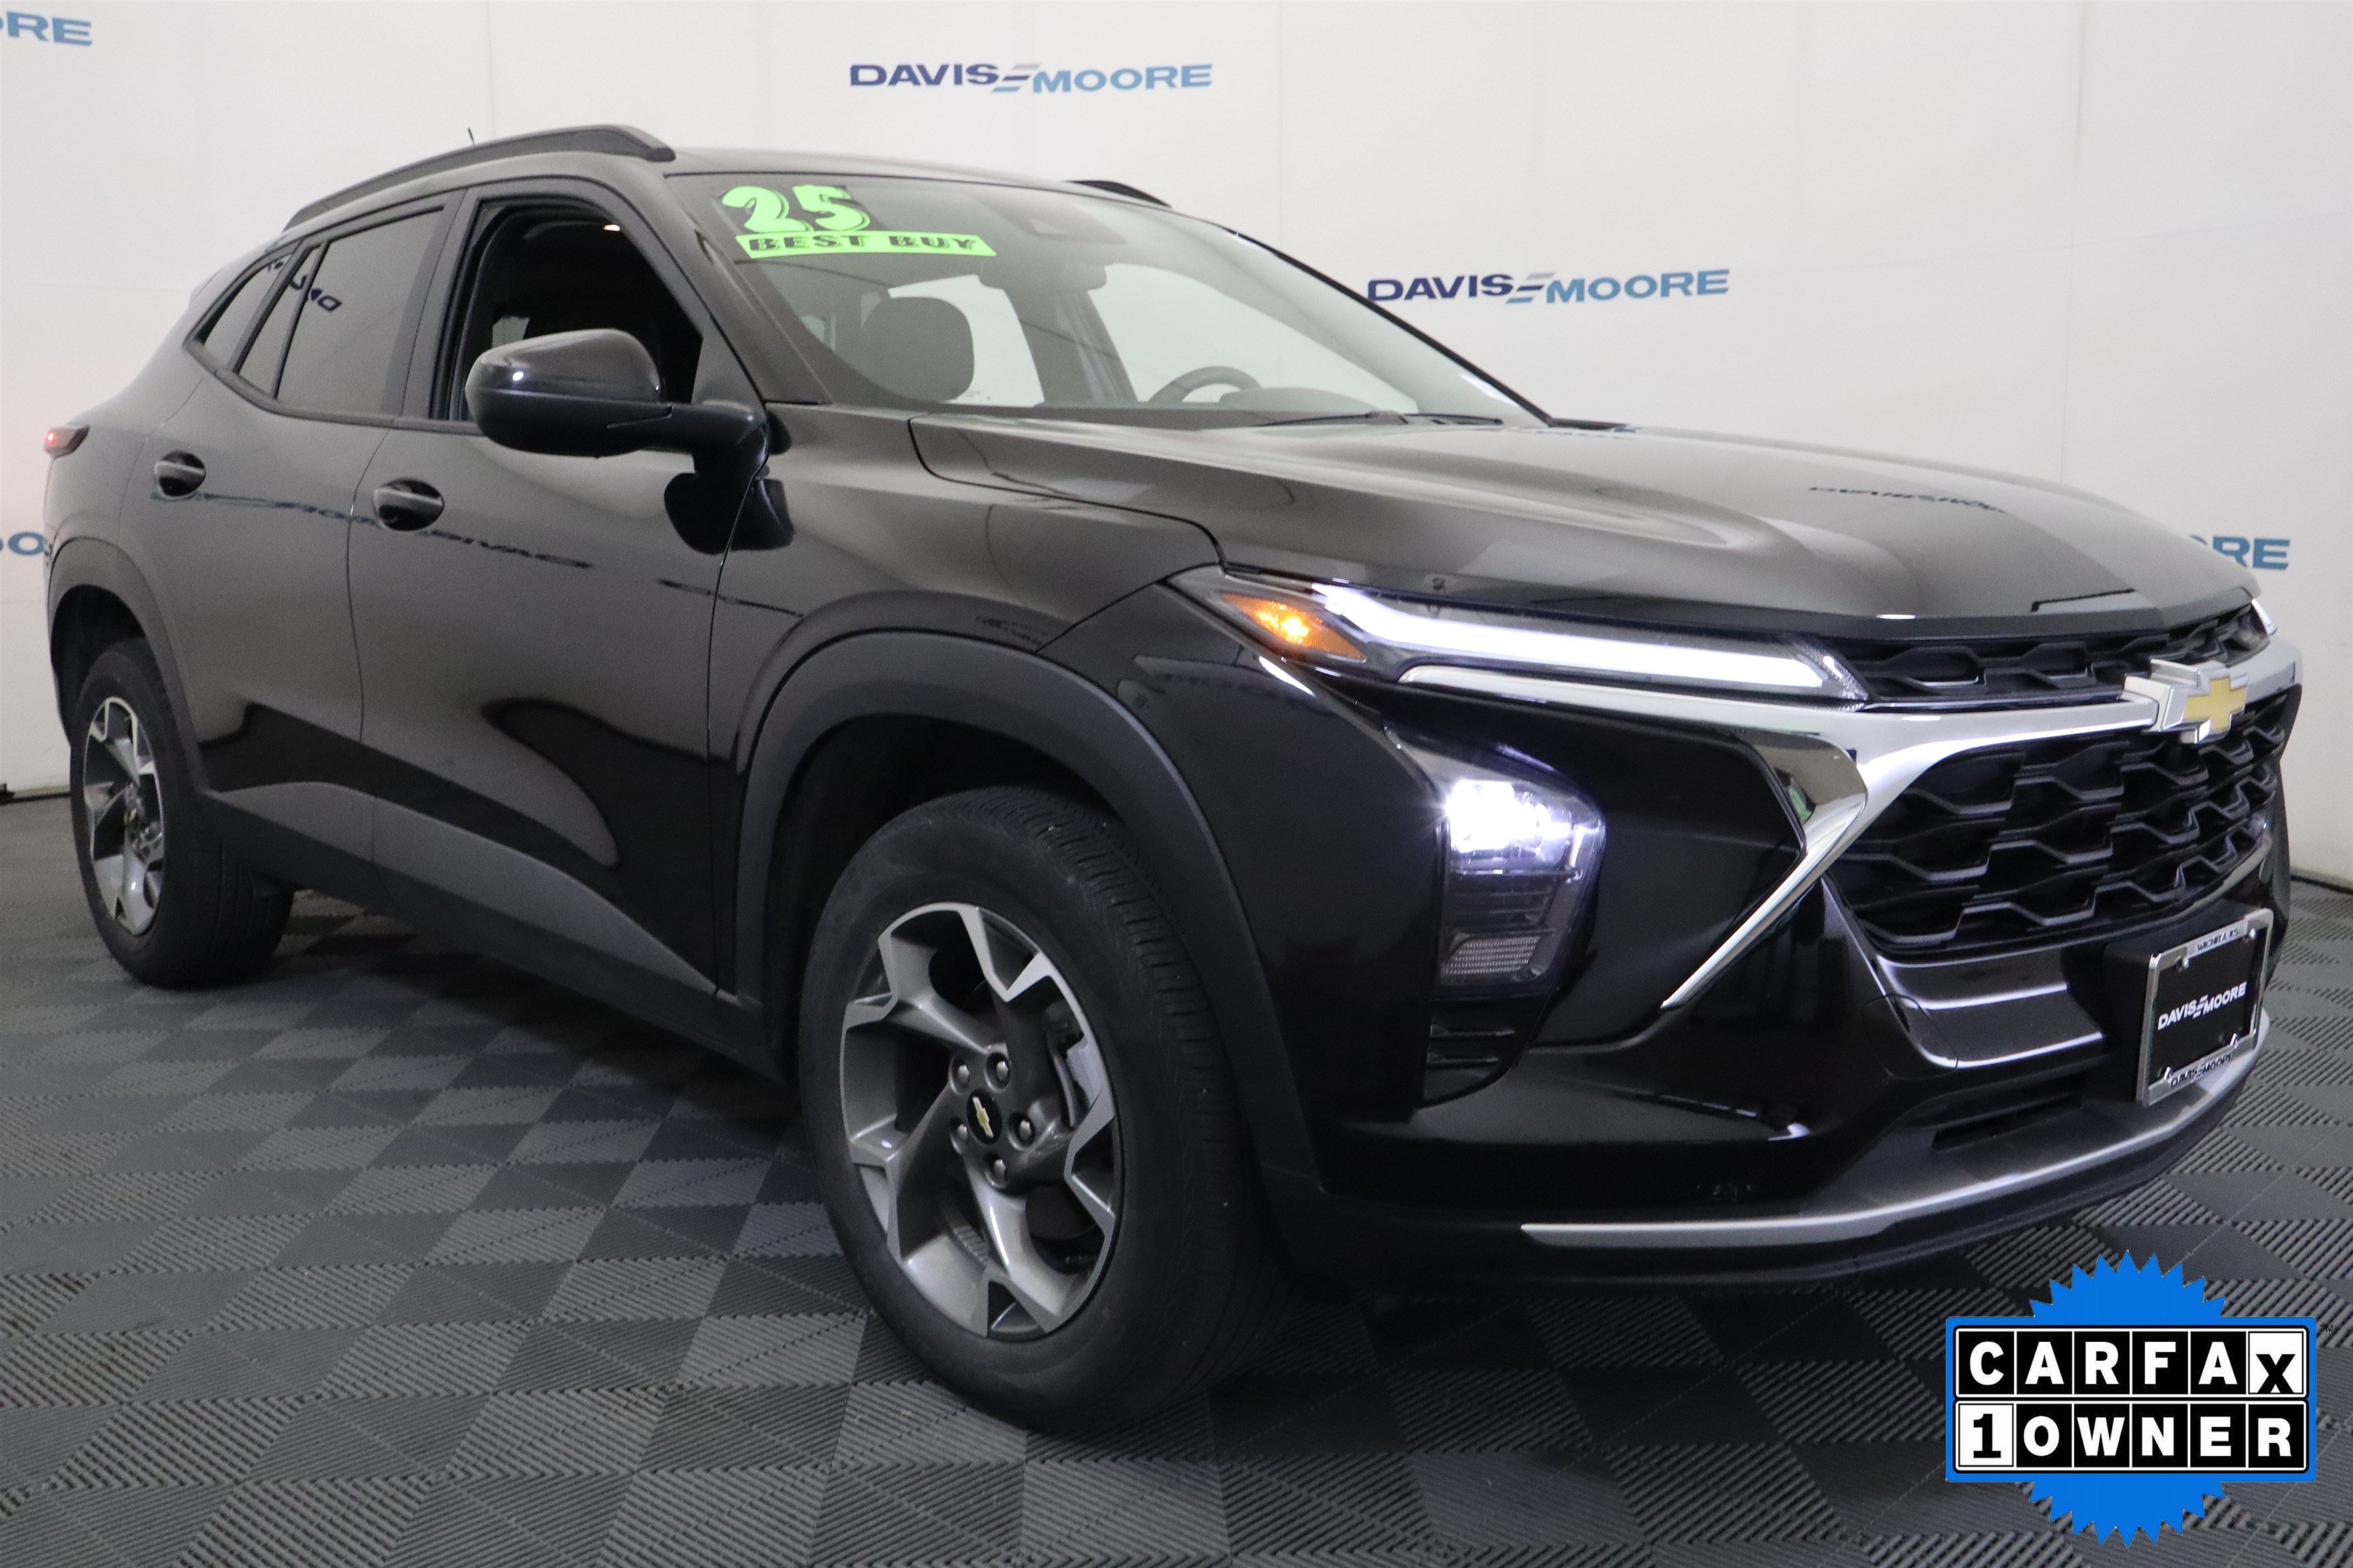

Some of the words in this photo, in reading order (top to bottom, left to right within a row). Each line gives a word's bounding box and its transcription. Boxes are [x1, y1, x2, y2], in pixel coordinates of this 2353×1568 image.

[850, 63, 999, 86] DAVIS
[1032, 63, 1213, 93] MOORE
[722, 184, 871, 233] 25
[749, 234, 869, 252] BEST
[888, 235, 976, 250] BUY
[1367, 273, 1514, 302] DAVIS
[1546, 268, 1730, 304] MOORE
[2157, 999, 2197, 1031] DAVIS
[2202, 981, 2247, 1015] MOORE
